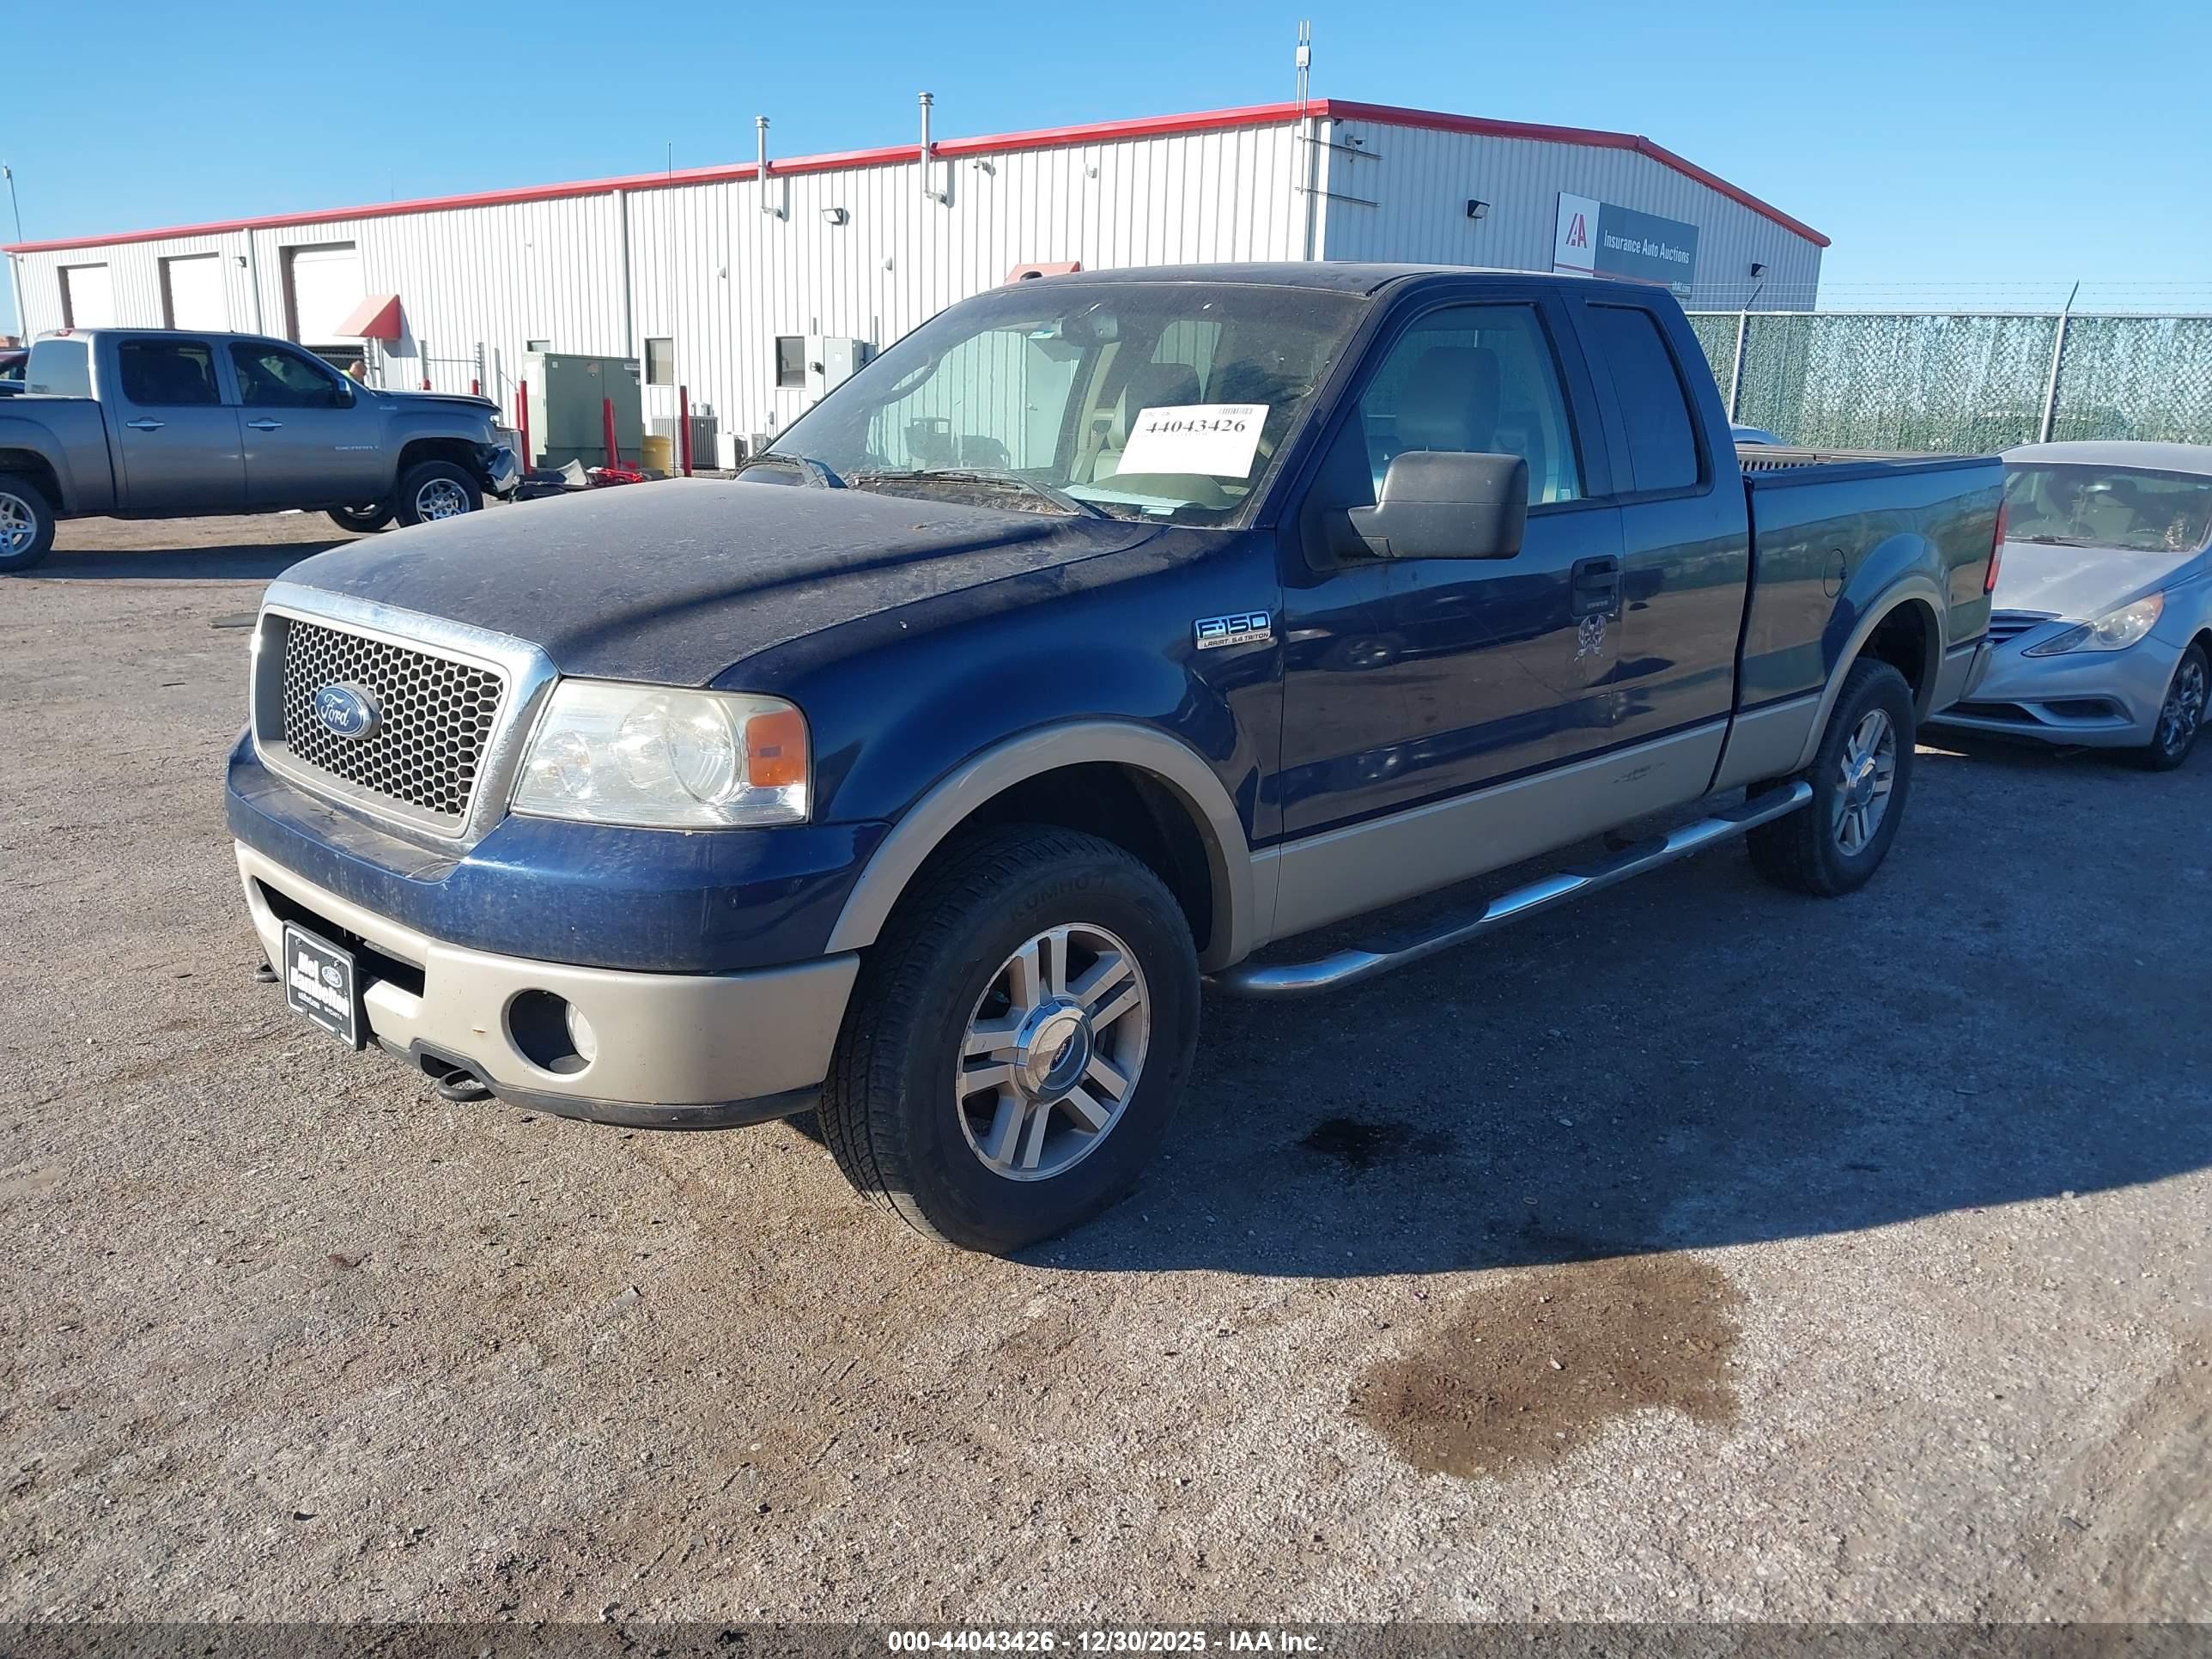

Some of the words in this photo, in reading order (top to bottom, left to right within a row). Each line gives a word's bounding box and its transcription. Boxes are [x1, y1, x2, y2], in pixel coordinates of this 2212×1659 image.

[1603, 229, 1640, 253] Insurance
[1642, 238, 1658, 258] Auto
[1659, 243, 1690, 264] Auctions
[1146, 419, 1247, 433] 44043426
[1204, 639, 1229, 647] LARIAT
[1244, 632, 1269, 641] TRITON
[321, 693, 350, 726] Ford
[298, 951, 319, 981] Mel
